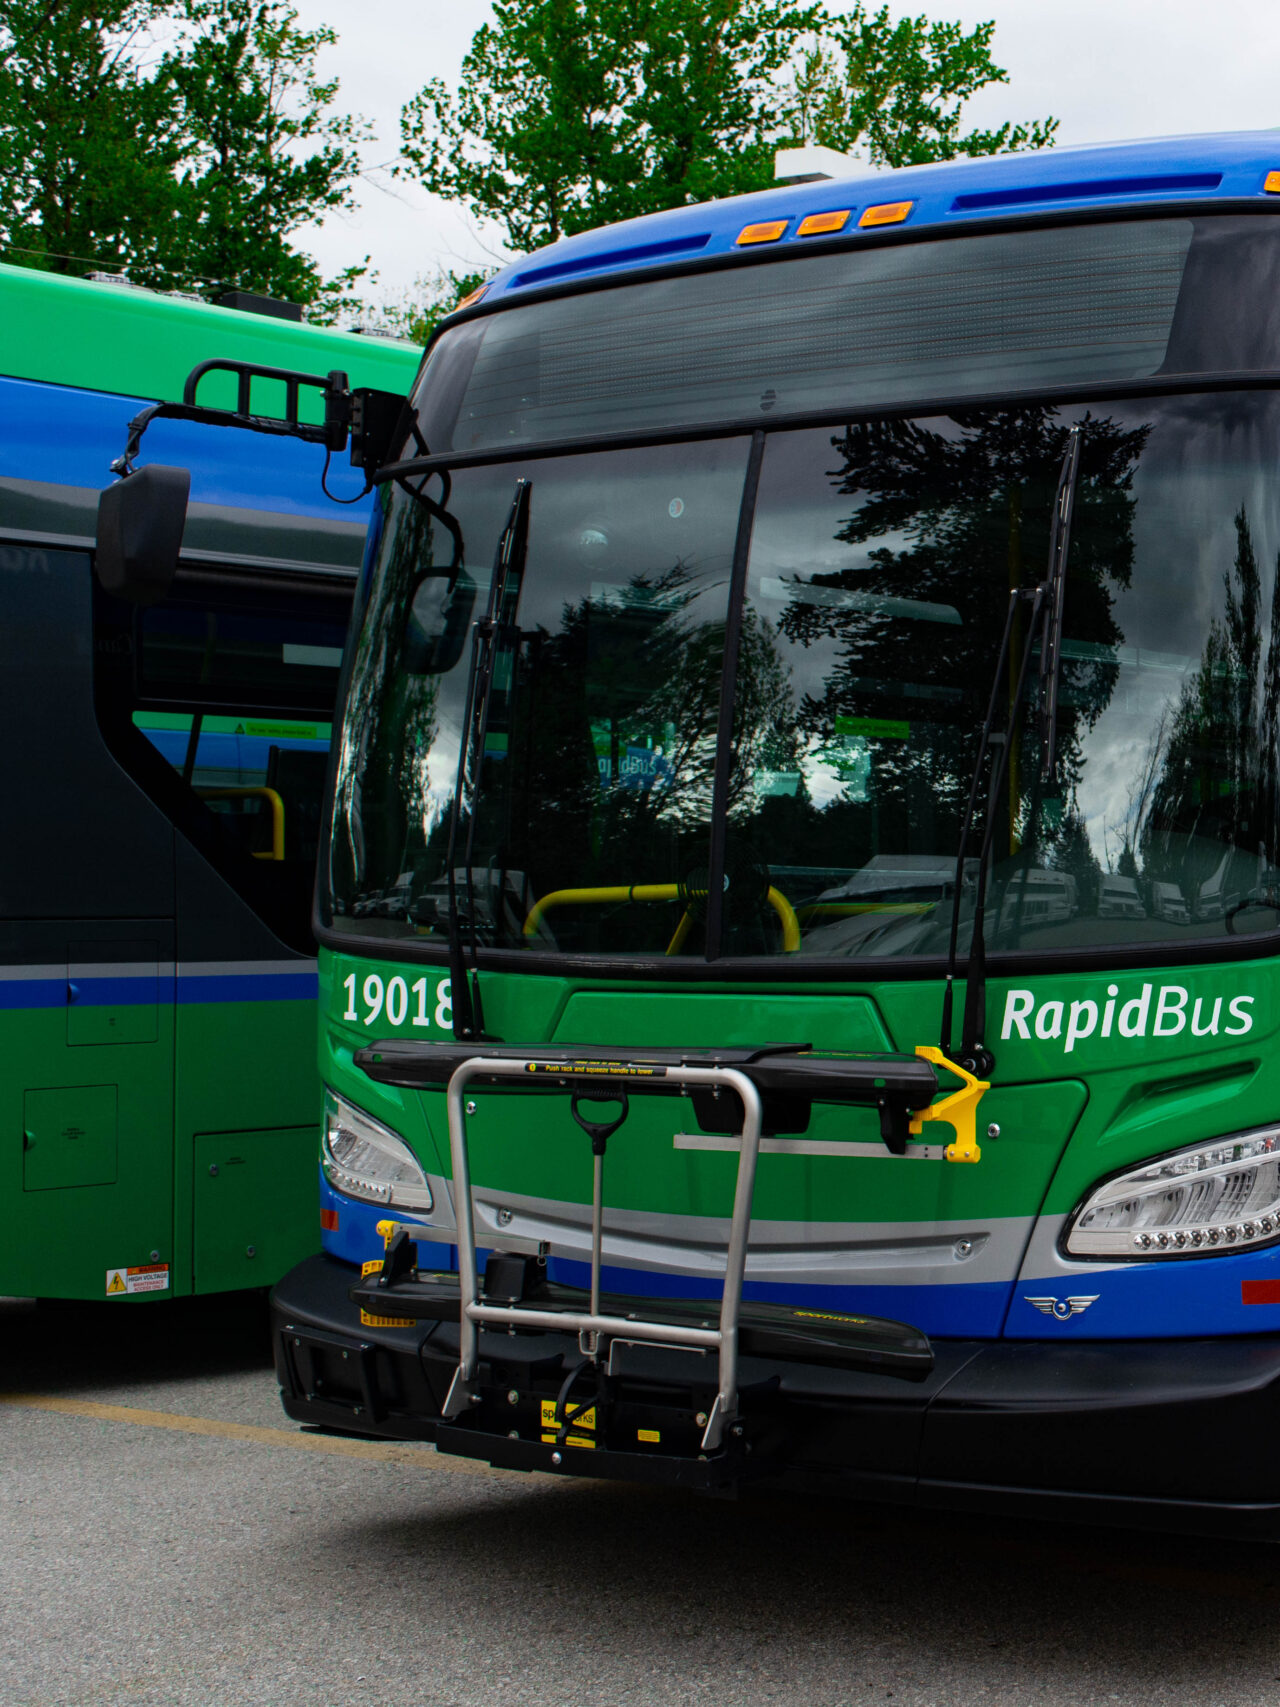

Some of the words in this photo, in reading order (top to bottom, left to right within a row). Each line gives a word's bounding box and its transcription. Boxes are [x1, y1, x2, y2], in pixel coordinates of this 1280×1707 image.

[343, 973, 454, 1030] 19018
[1000, 983, 1255, 1054] RapidBus
[545, 1064, 560, 1072] Push
[586, 1066, 609, 1075] squeeze
[609, 1066, 629, 1074] handle
[629, 1067, 636, 1075] to
[143, 1272, 168, 1281] VOLTAGE
